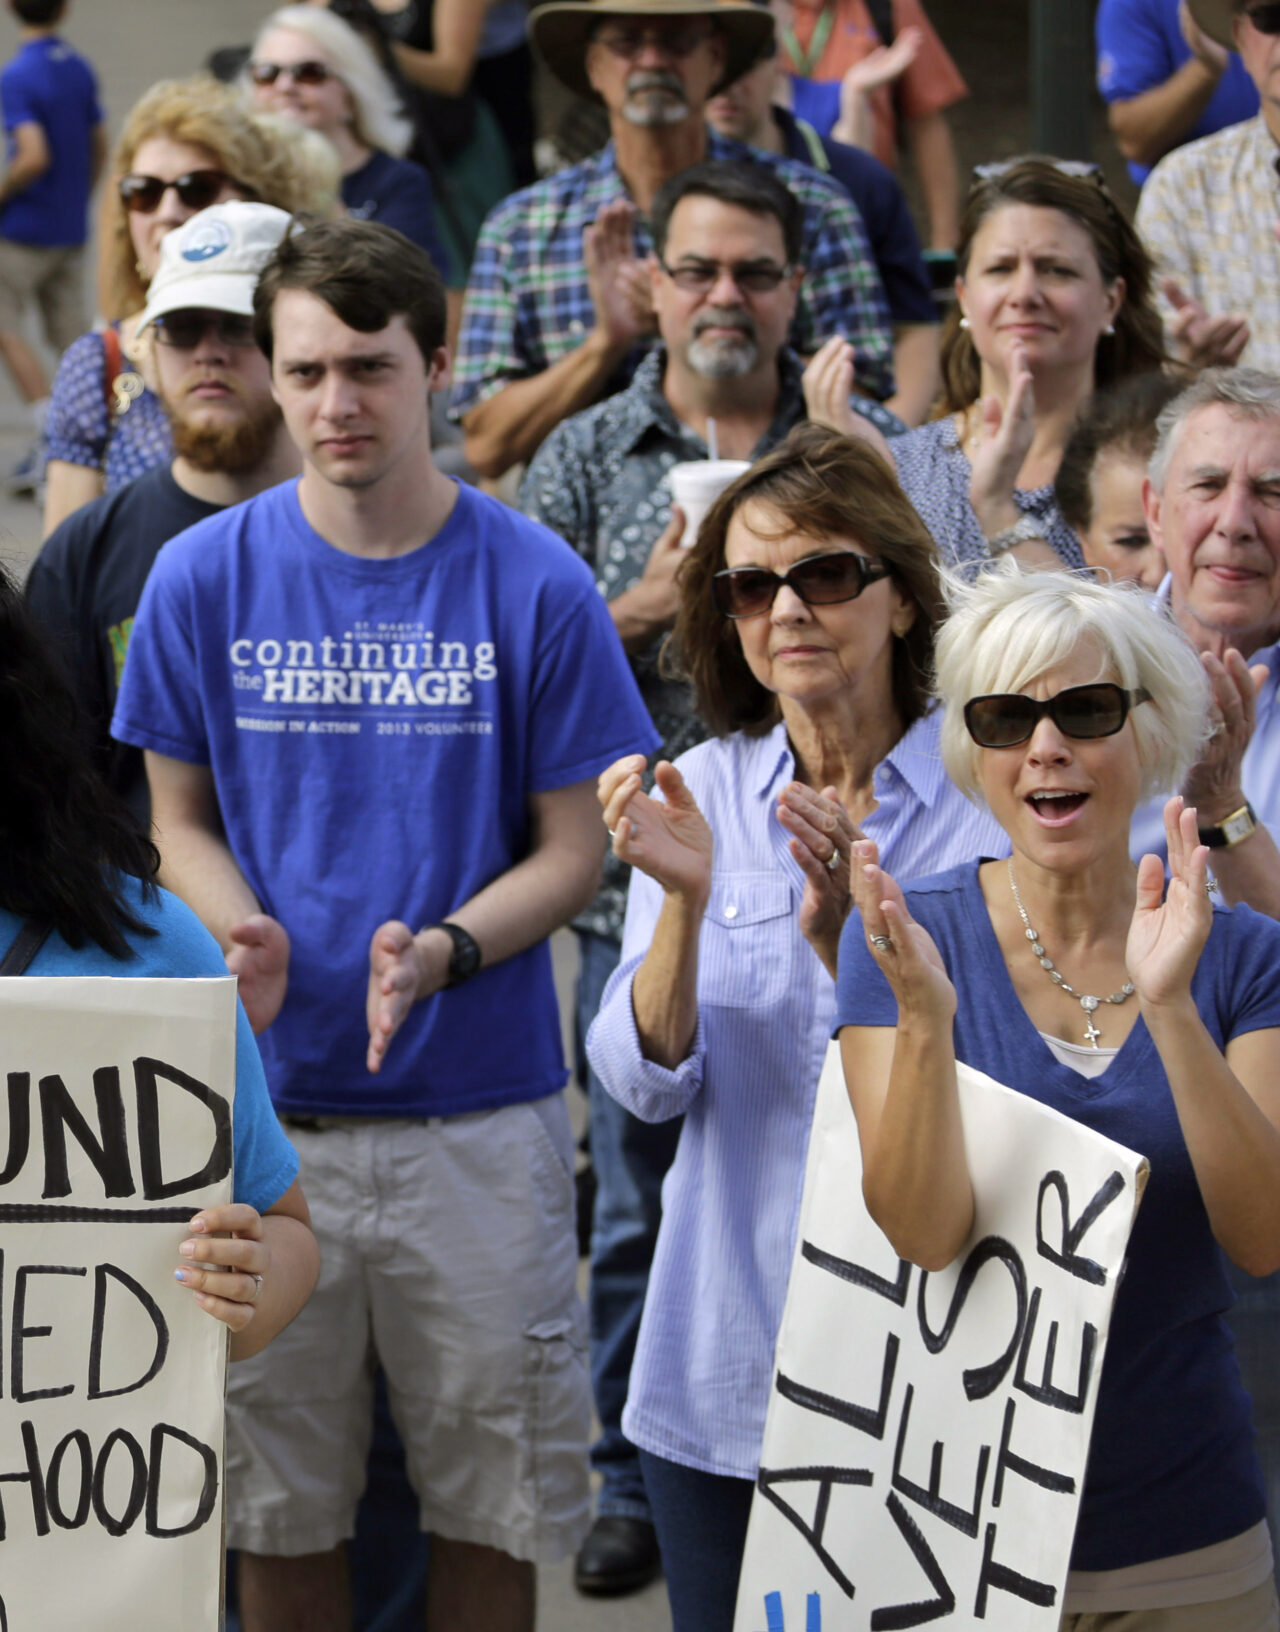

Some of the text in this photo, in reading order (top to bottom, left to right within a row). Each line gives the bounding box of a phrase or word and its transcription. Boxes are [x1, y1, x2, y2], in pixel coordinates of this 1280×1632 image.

[229, 632, 498, 681] continuing
[233, 668, 472, 705] the HERITAGE
[288, 720, 306, 732] IN
[307, 720, 361, 734] ACTION
[376, 721, 411, 735] 2013
[414, 721, 493, 736] VOLUNTEER
